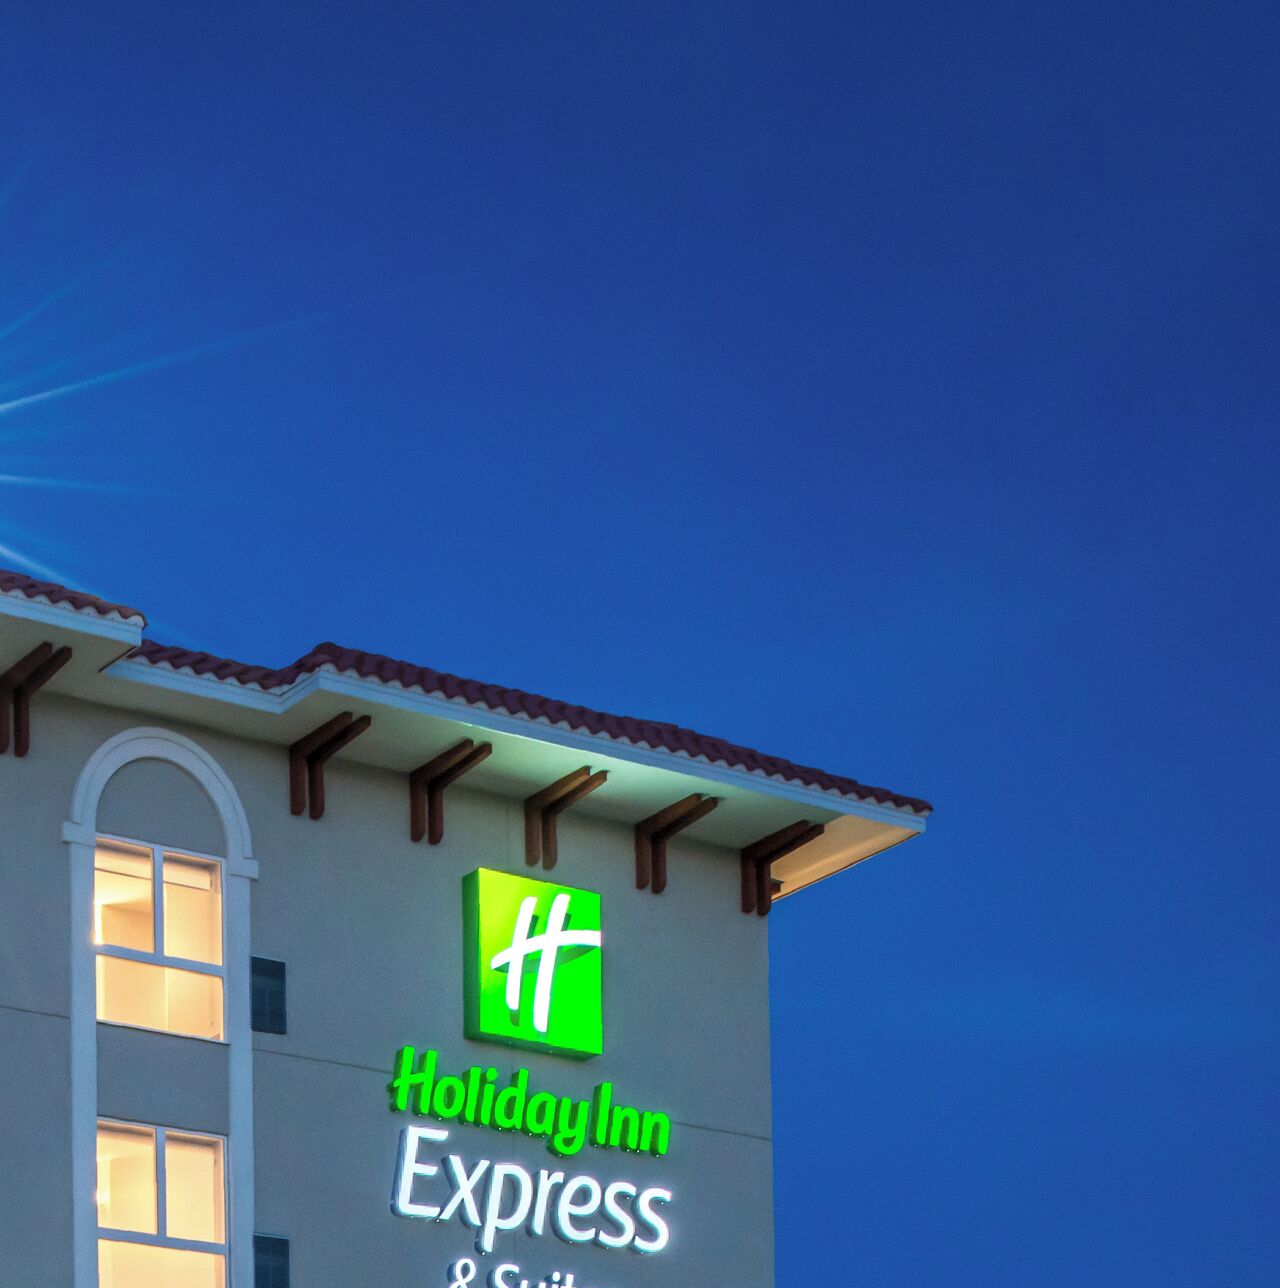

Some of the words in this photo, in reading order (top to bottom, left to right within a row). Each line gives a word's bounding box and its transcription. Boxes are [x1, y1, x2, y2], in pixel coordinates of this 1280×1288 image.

[390, 1045, 589, 1157] Holiday
[592, 1081, 671, 1156] Inn
[392, 1125, 672, 1253] Express
